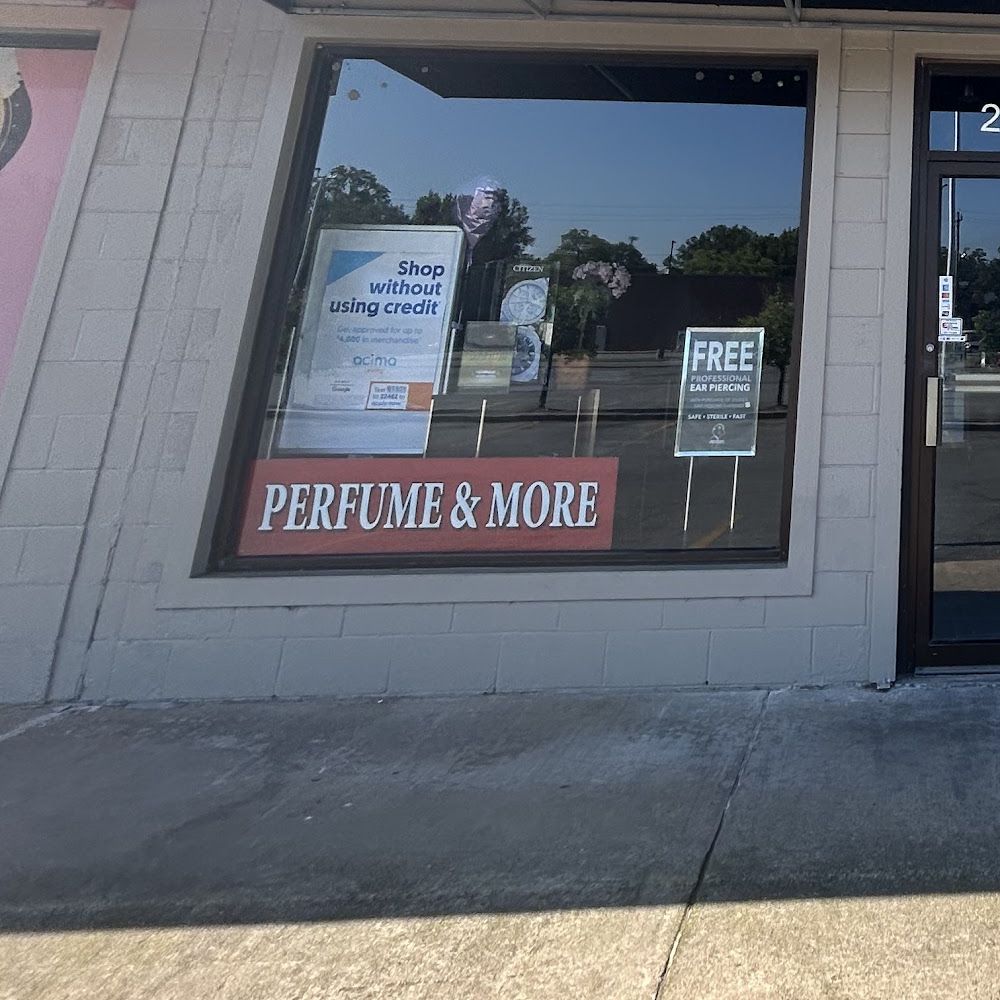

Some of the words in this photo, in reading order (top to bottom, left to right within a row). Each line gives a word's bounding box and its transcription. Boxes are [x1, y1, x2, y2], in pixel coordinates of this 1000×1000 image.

[397, 260, 445, 280] Shop
[512, 264, 545, 273] CITIZEN
[369, 278, 443, 296] without
[329, 297, 380, 318] using
[353, 353, 397, 367] acima
[691, 340, 755, 372] FREE
[691, 374, 751, 382] PROFESSIONAL
[689, 383, 708, 392] EAR
[709, 383, 751, 392] PIERCING
[257, 482, 444, 531] PERFUME
[449, 481, 482, 529] &
[485, 481, 598, 528] MORE
